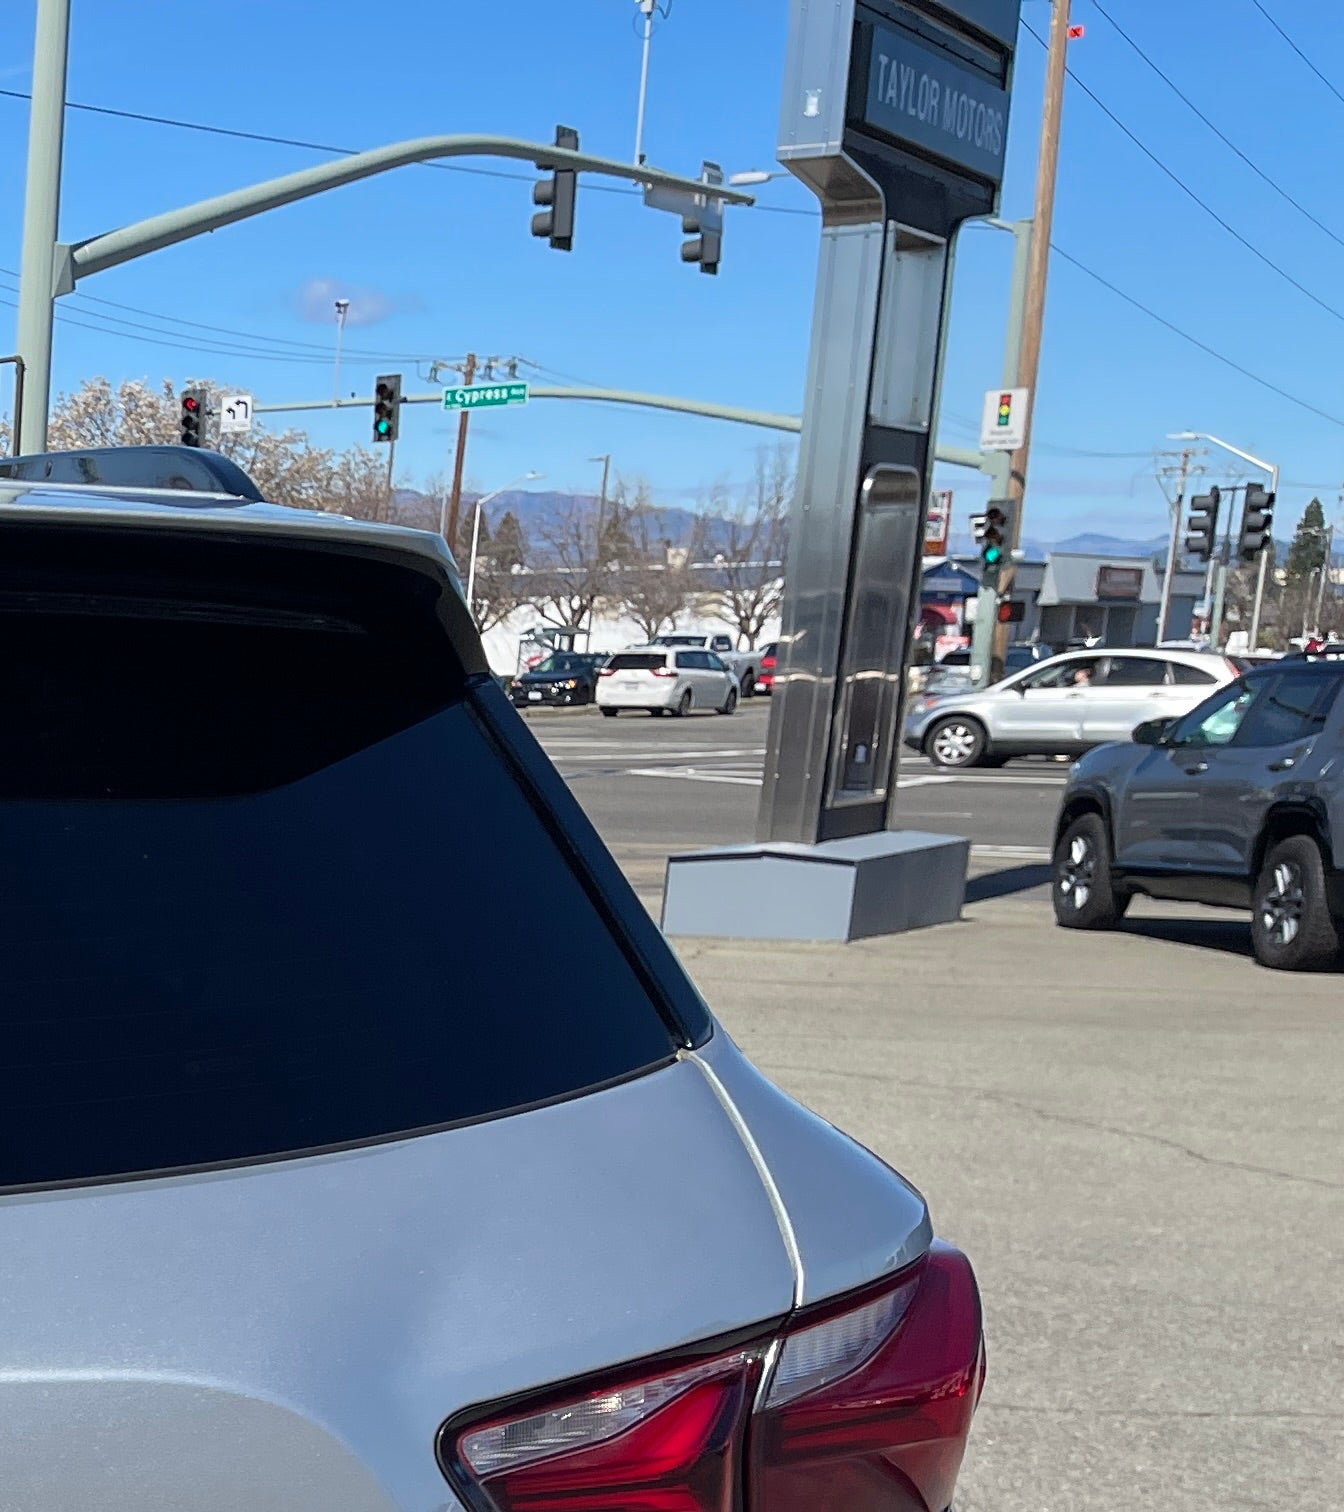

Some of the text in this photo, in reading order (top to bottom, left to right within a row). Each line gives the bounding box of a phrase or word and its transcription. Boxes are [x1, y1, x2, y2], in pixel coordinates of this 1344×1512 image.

[877, 53, 1004, 156] TAYLOR MOTORS
[455, 388, 508, 405] Cypress
